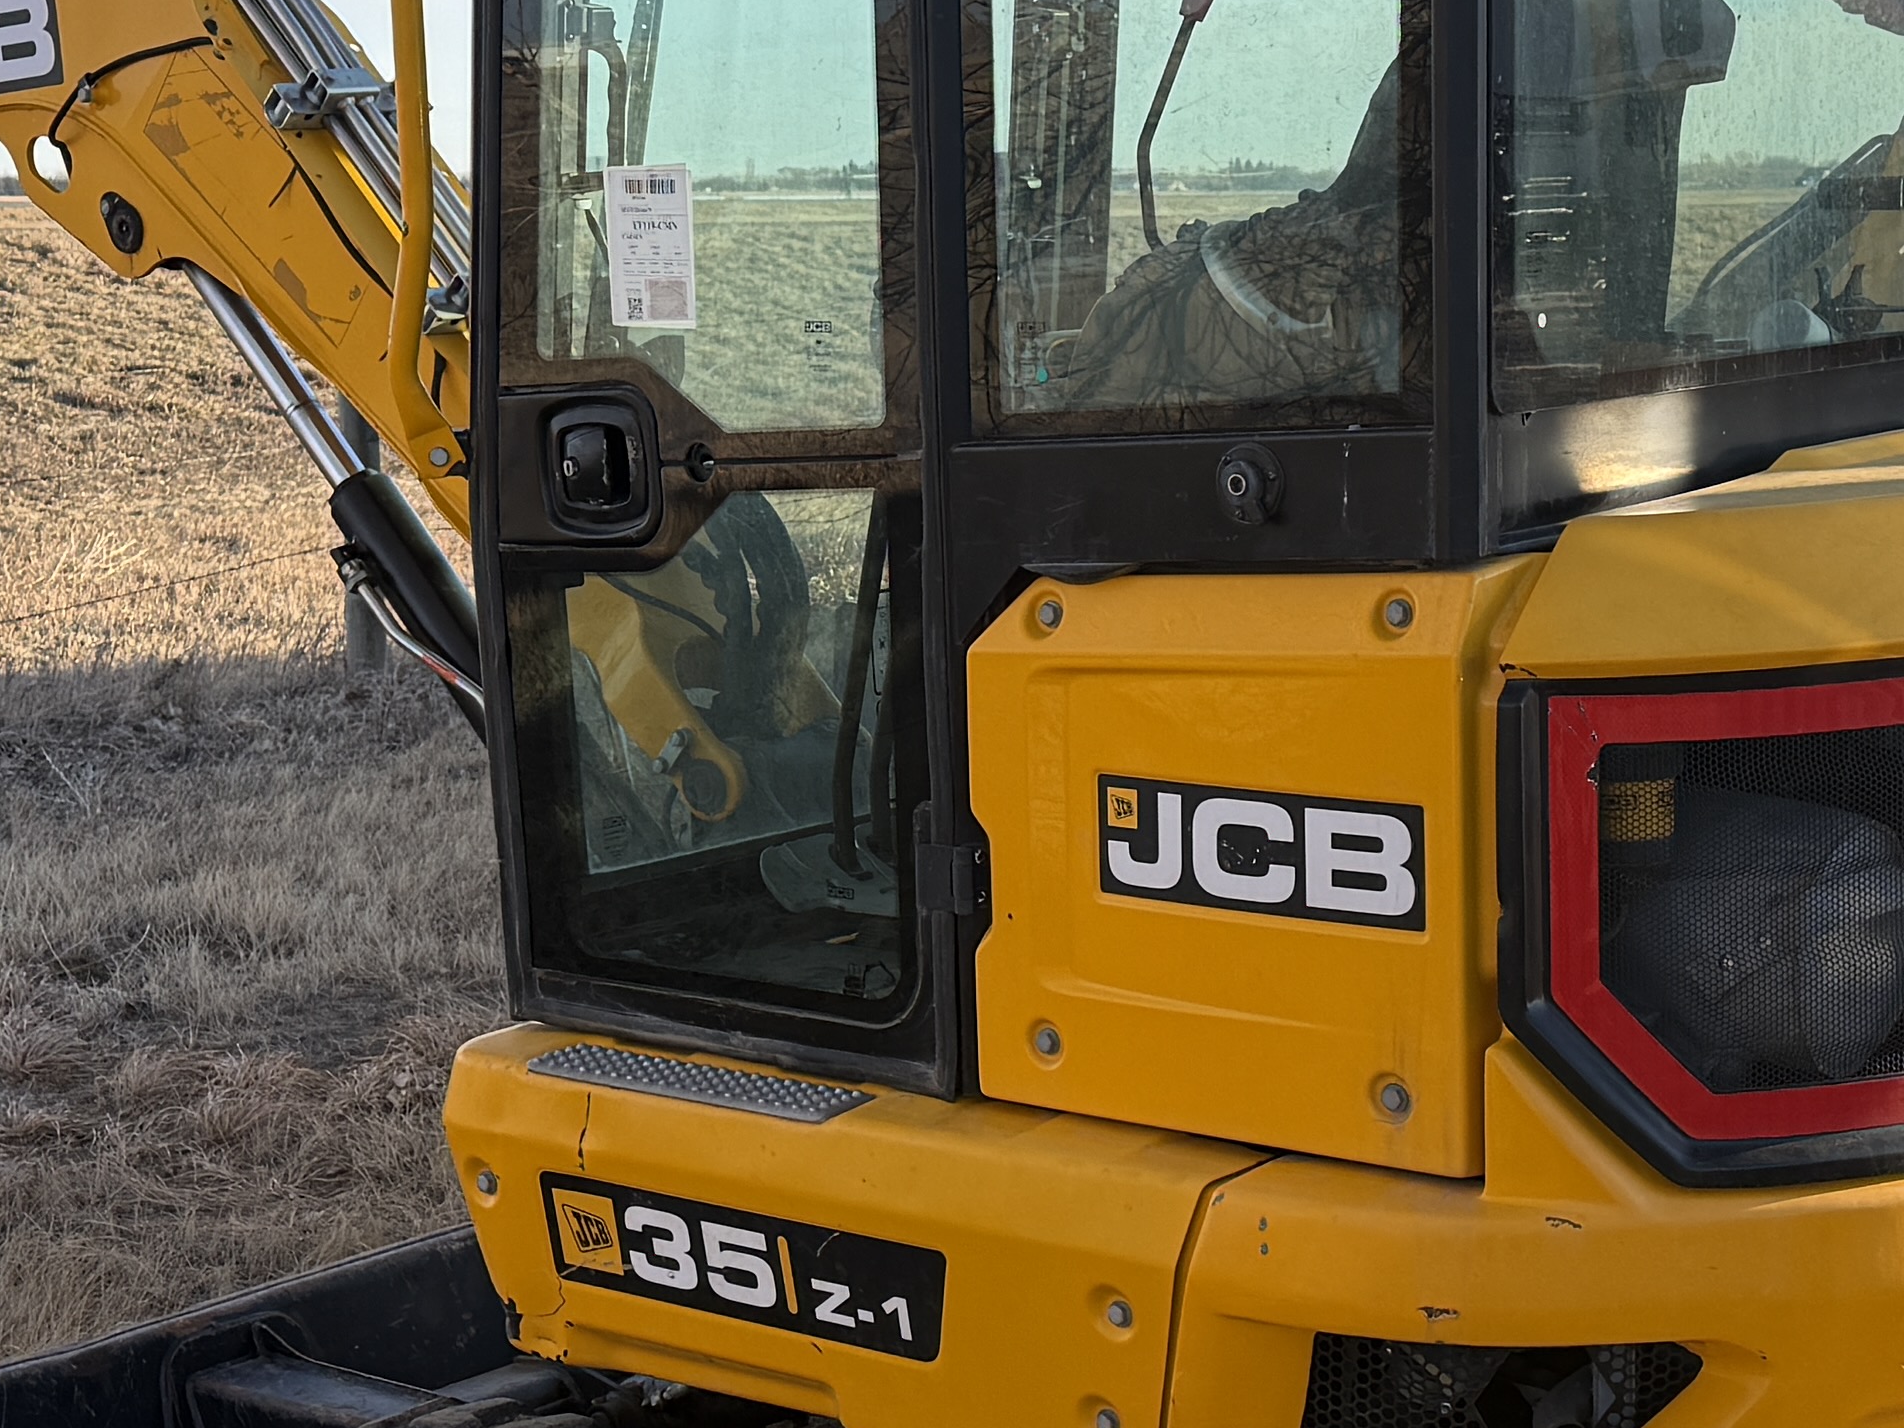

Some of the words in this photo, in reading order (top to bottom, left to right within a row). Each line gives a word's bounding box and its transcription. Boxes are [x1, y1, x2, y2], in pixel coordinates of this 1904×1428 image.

[1106, 792, 1415, 917] JCB
[571, 1207, 612, 1252] JCB
[624, 1205, 777, 1310] 35
[810, 1277, 915, 1343] Z-1
